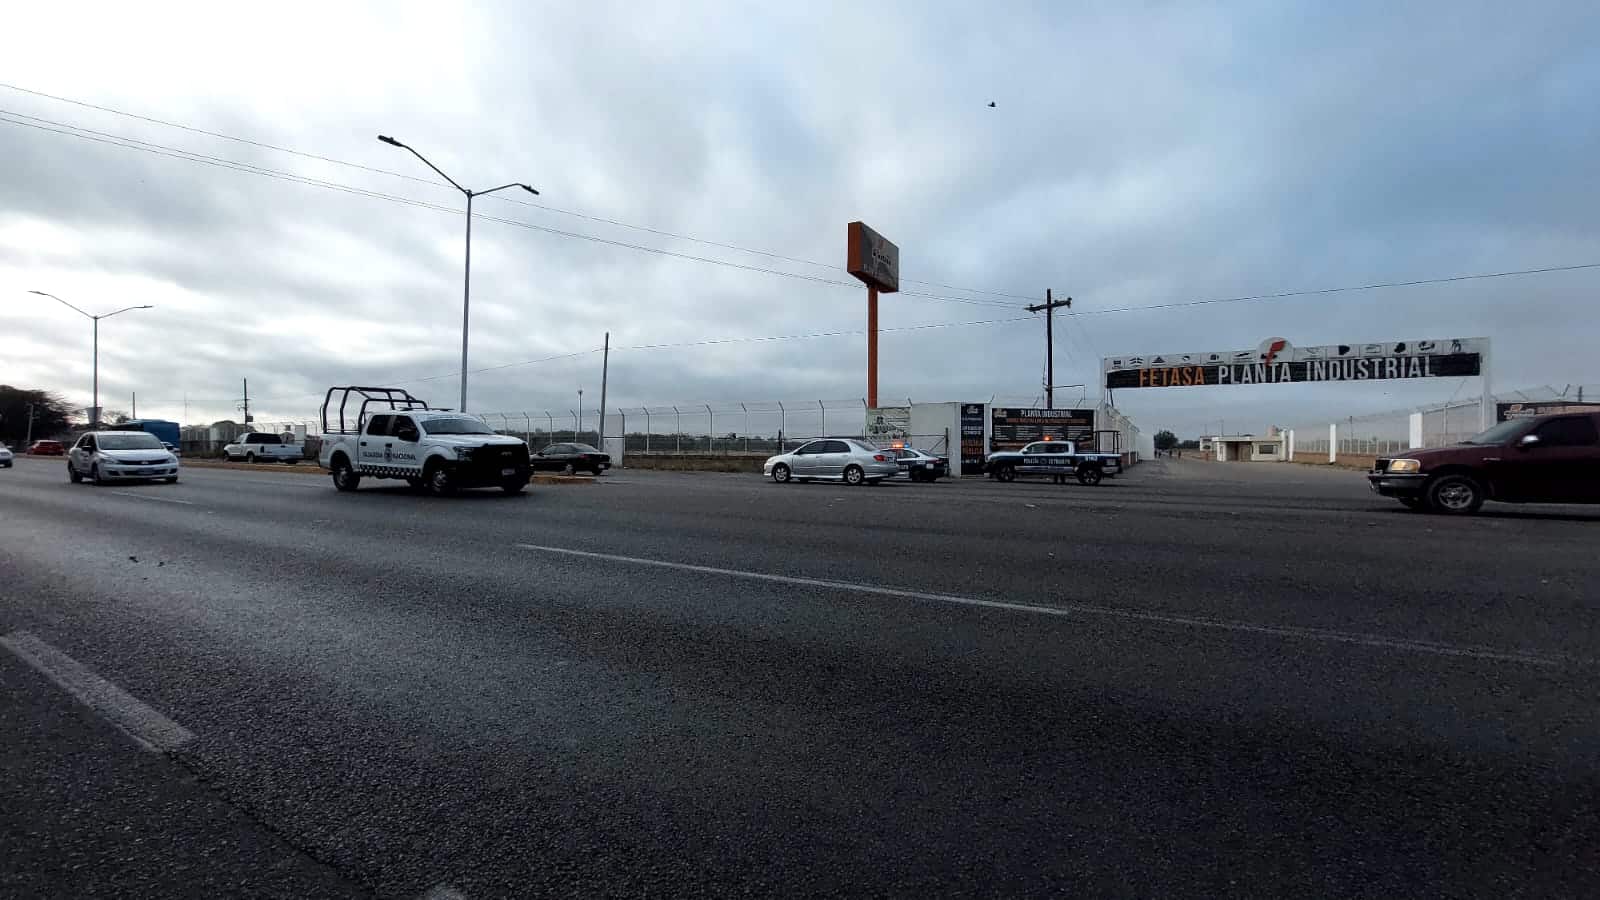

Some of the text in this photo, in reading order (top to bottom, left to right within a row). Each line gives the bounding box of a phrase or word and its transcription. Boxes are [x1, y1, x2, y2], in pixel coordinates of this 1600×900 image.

[1139, 355, 1435, 387] FETASA PLANTA INDUSTRIAL
